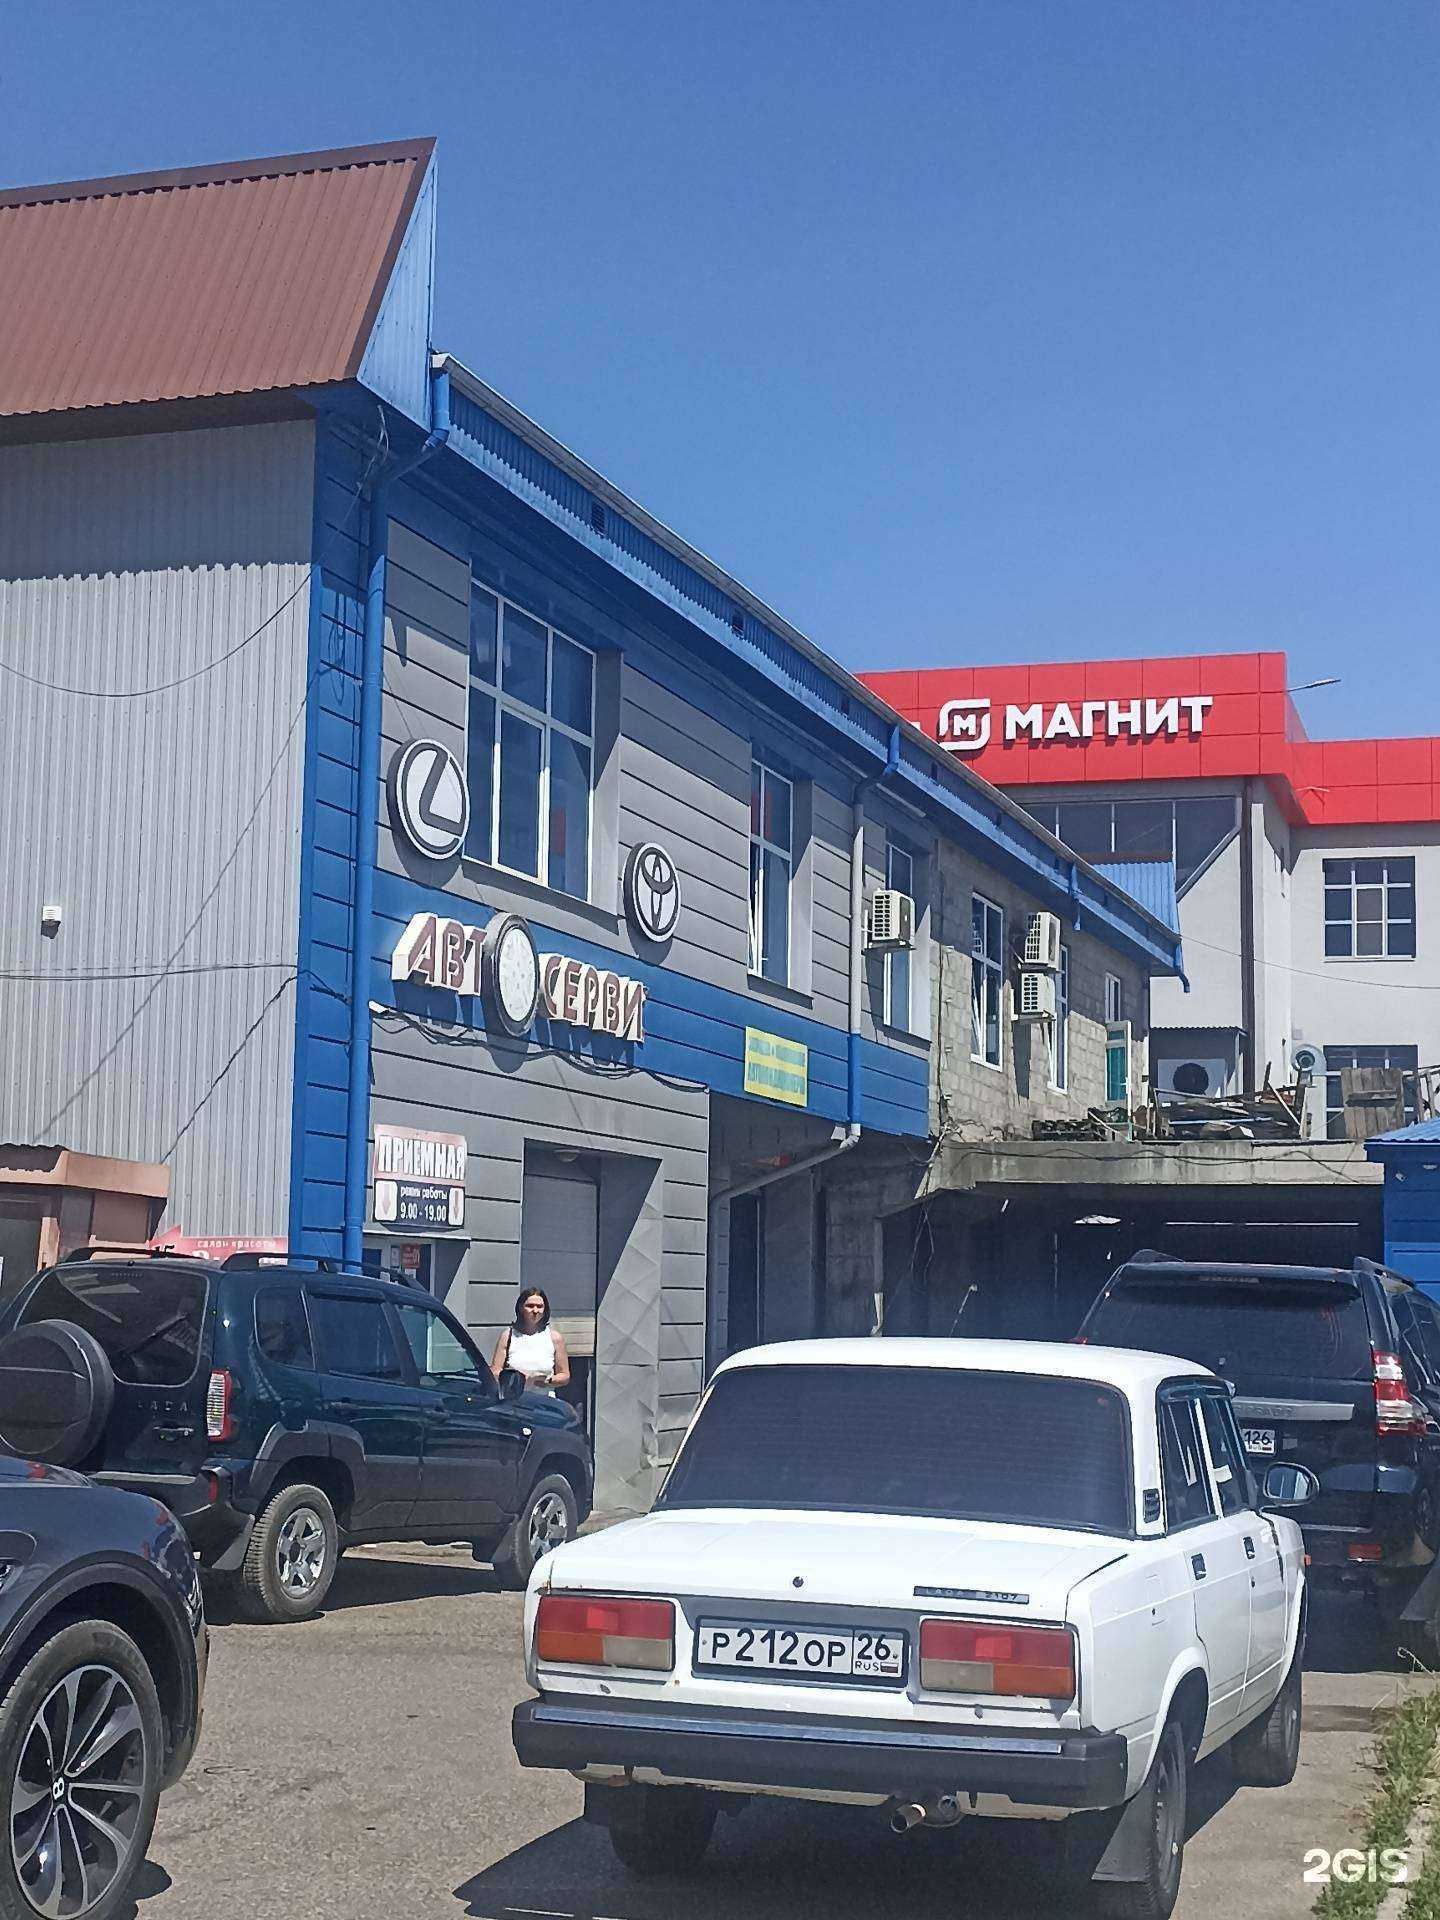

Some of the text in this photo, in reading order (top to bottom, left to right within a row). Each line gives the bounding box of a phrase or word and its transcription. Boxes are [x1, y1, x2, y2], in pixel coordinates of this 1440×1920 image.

[1005, 697, 1213, 741] МАГНИТ
[377, 1135, 466, 1180] ПРИЕМНАЯ
[400, 1202, 418, 1220] 9.00
[424, 1204, 447, 1221] 19.00
[1243, 1430, 1272, 1446] 126
[857, 1633, 890, 1661] 26
[855, 1661, 879, 1672] RUS
